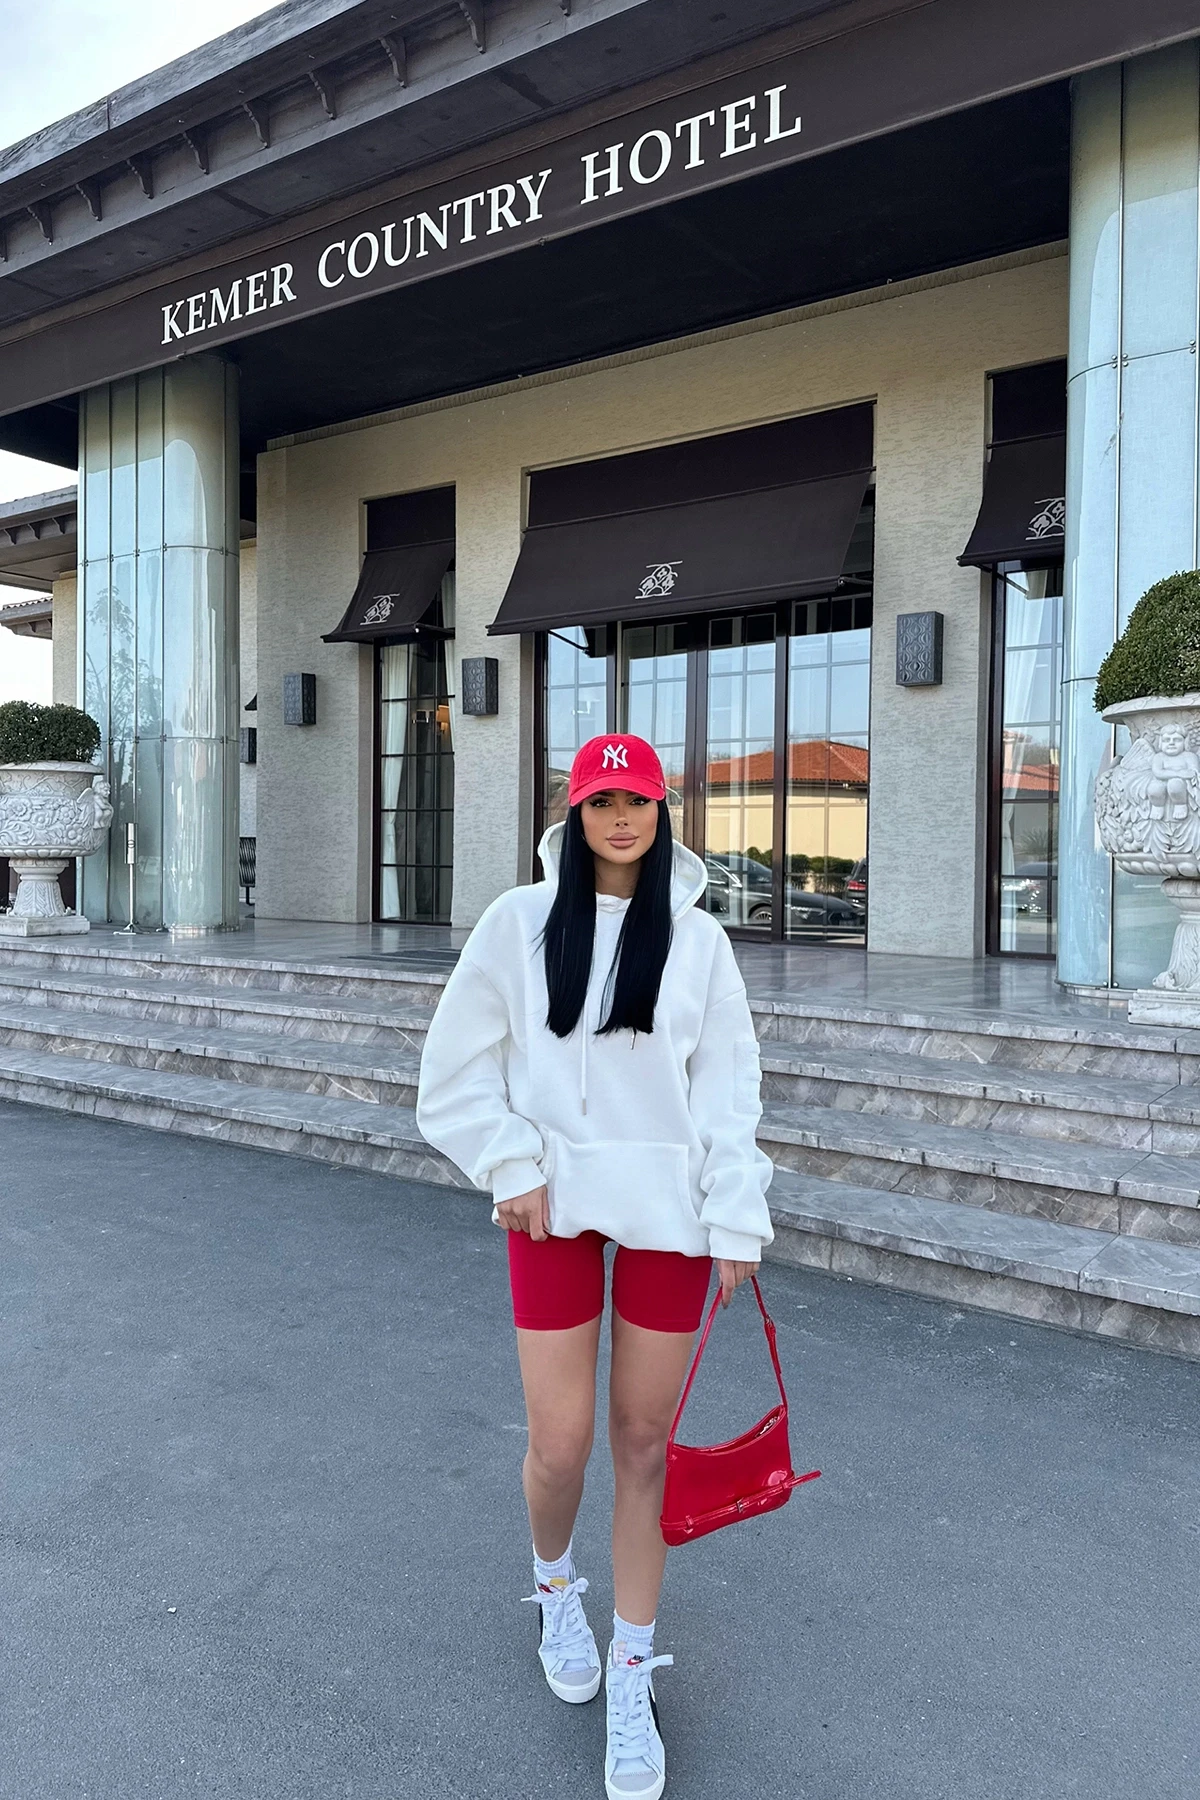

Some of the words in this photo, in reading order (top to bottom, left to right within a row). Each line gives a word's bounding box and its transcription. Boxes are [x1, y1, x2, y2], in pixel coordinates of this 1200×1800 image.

[161, 262, 297, 345] KEMER
[317, 168, 553, 288] COUNTRY
[580, 84, 802, 205] HOTEL
[601, 743, 629, 769] NY
